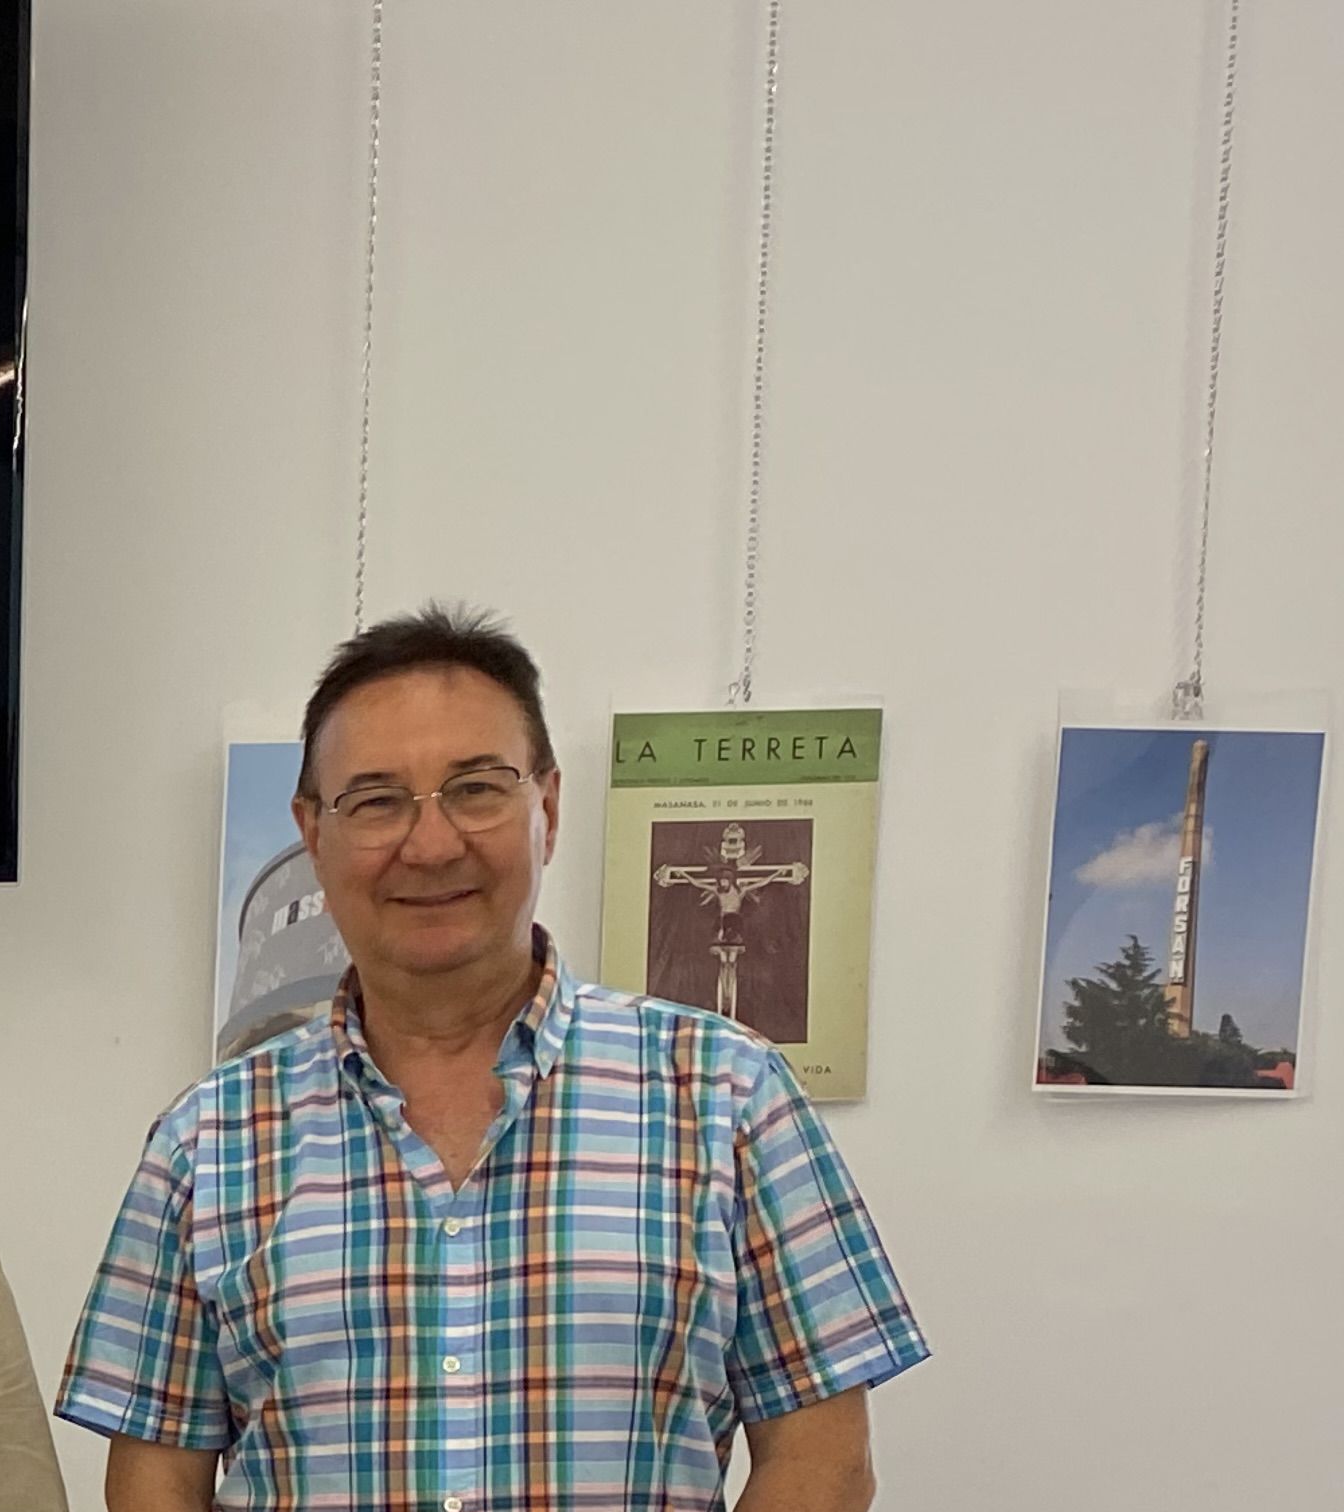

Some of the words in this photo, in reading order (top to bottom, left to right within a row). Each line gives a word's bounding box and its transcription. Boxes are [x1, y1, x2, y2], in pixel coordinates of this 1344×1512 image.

[615, 740, 657, 763] LA
[693, 736, 858, 762] TERRETA
[271, 889, 326, 937] mass
[803, 1065, 832, 1075] VIDA
